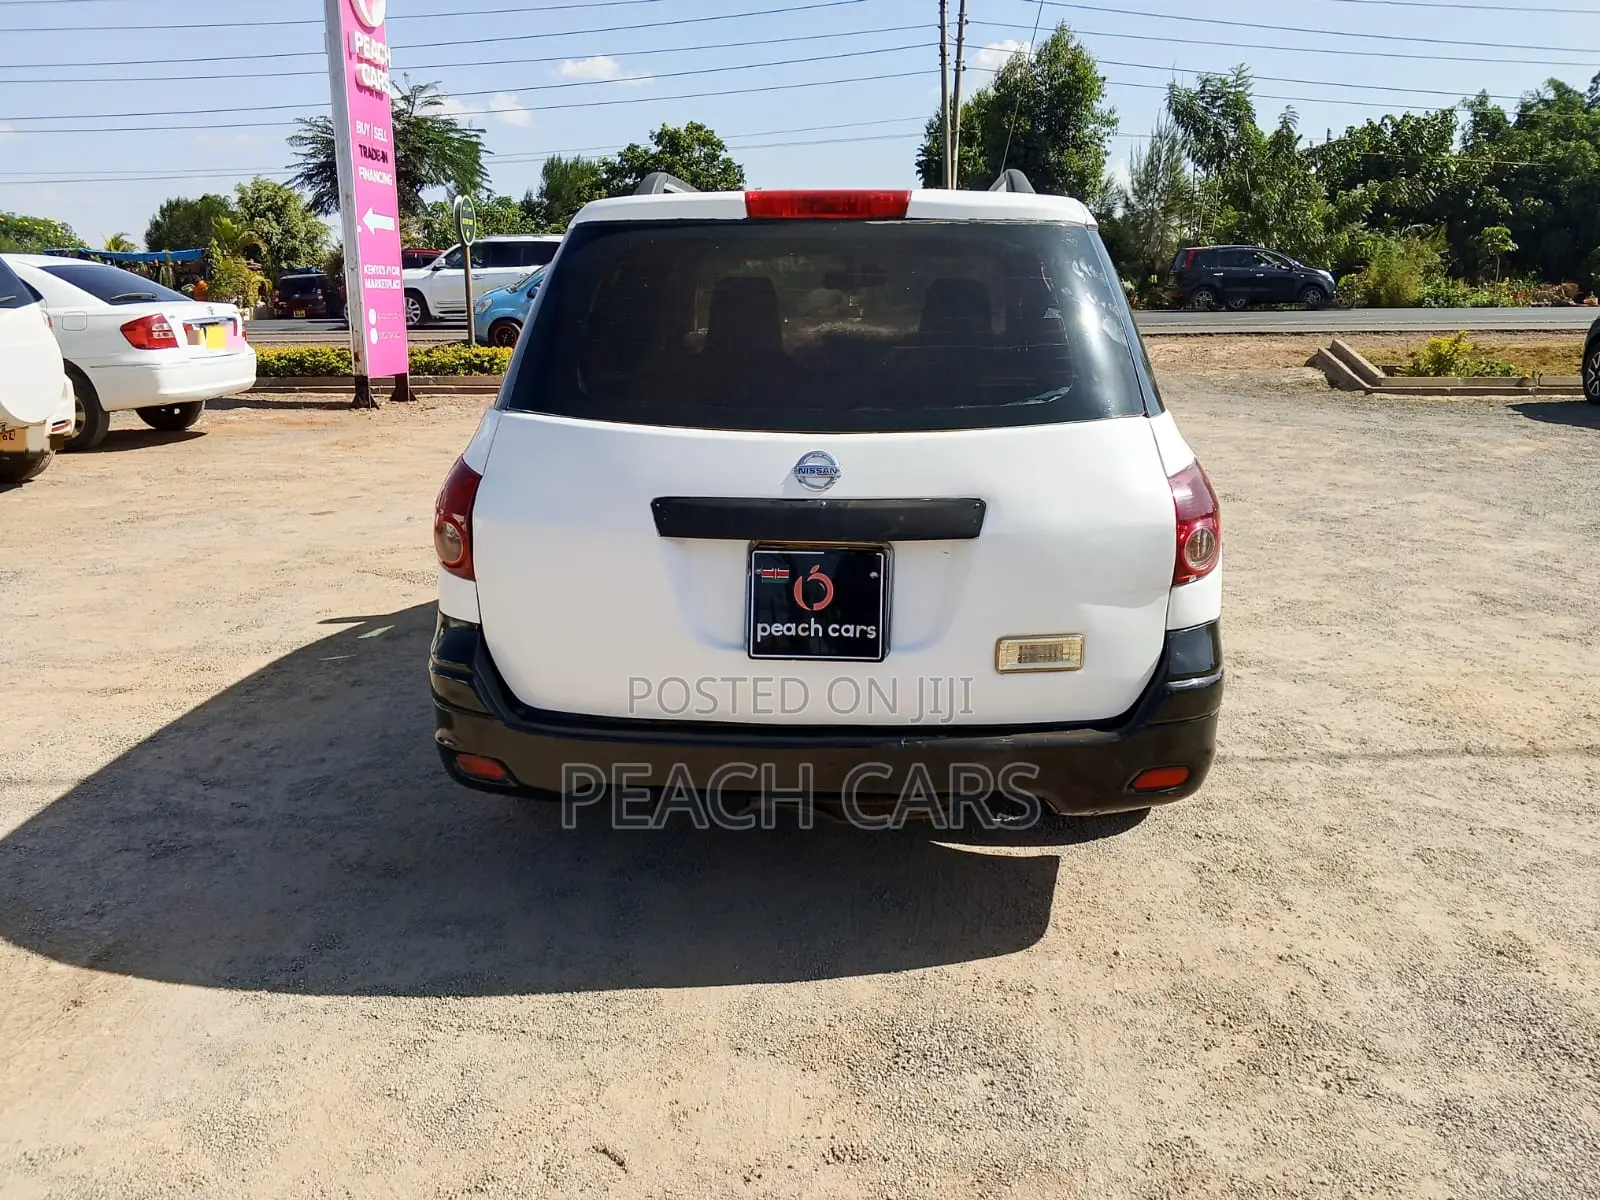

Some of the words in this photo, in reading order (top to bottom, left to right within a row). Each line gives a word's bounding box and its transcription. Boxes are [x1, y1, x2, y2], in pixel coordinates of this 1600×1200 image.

[352, 31, 391, 68] PEACH
[358, 63, 390, 95] CARS
[355, 119, 370, 137] BUY
[373, 126, 389, 143] SELL
[358, 166, 393, 186] FINANCING
[798, 467, 837, 475] NISSAN
[756, 618, 823, 642] peach
[828, 622, 877, 639] cars
